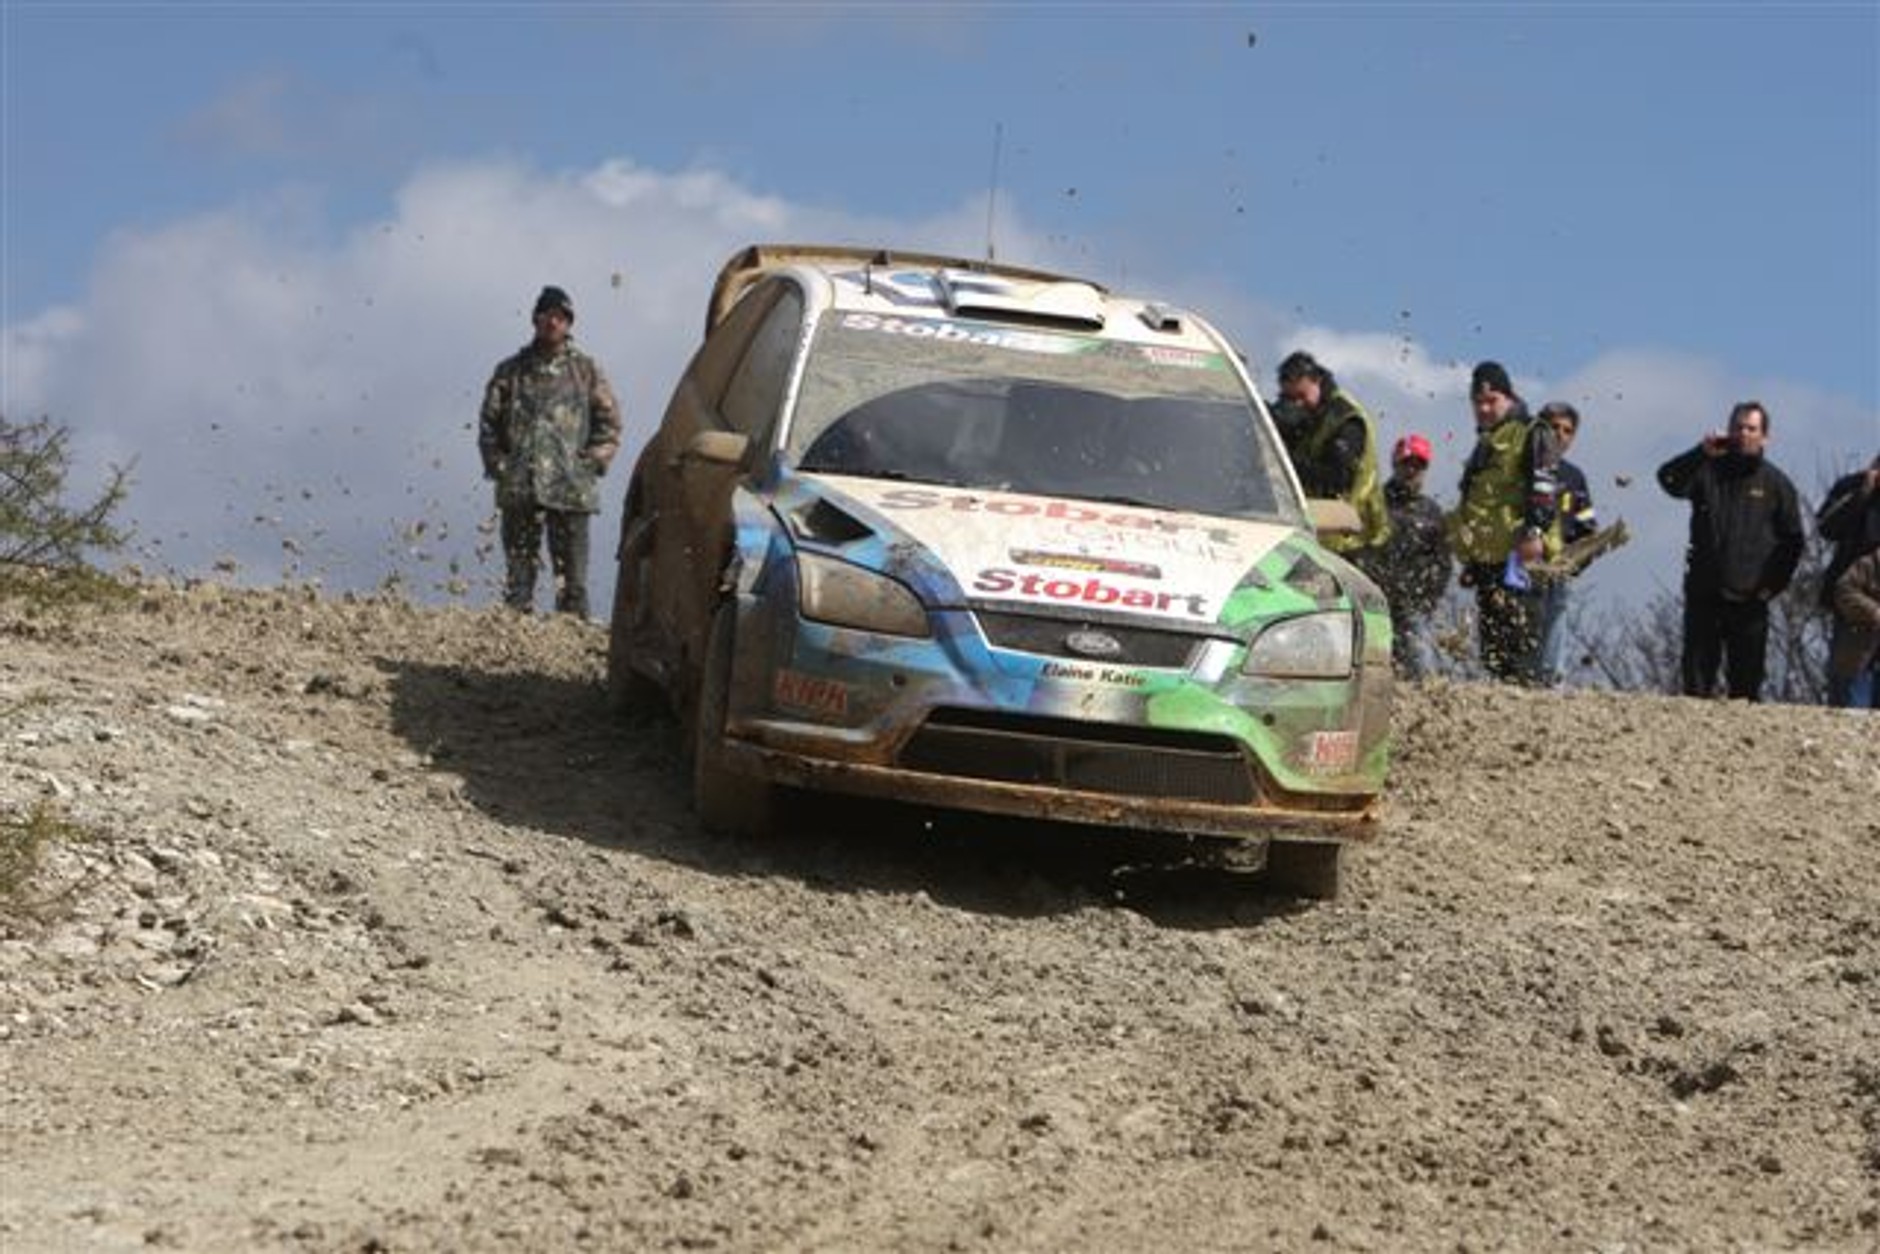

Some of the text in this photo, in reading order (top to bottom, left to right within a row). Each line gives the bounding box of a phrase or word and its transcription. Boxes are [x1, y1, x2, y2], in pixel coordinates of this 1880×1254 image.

[973, 568, 1209, 617] Stobart
[1041, 662, 1147, 688] Elaine Katie
